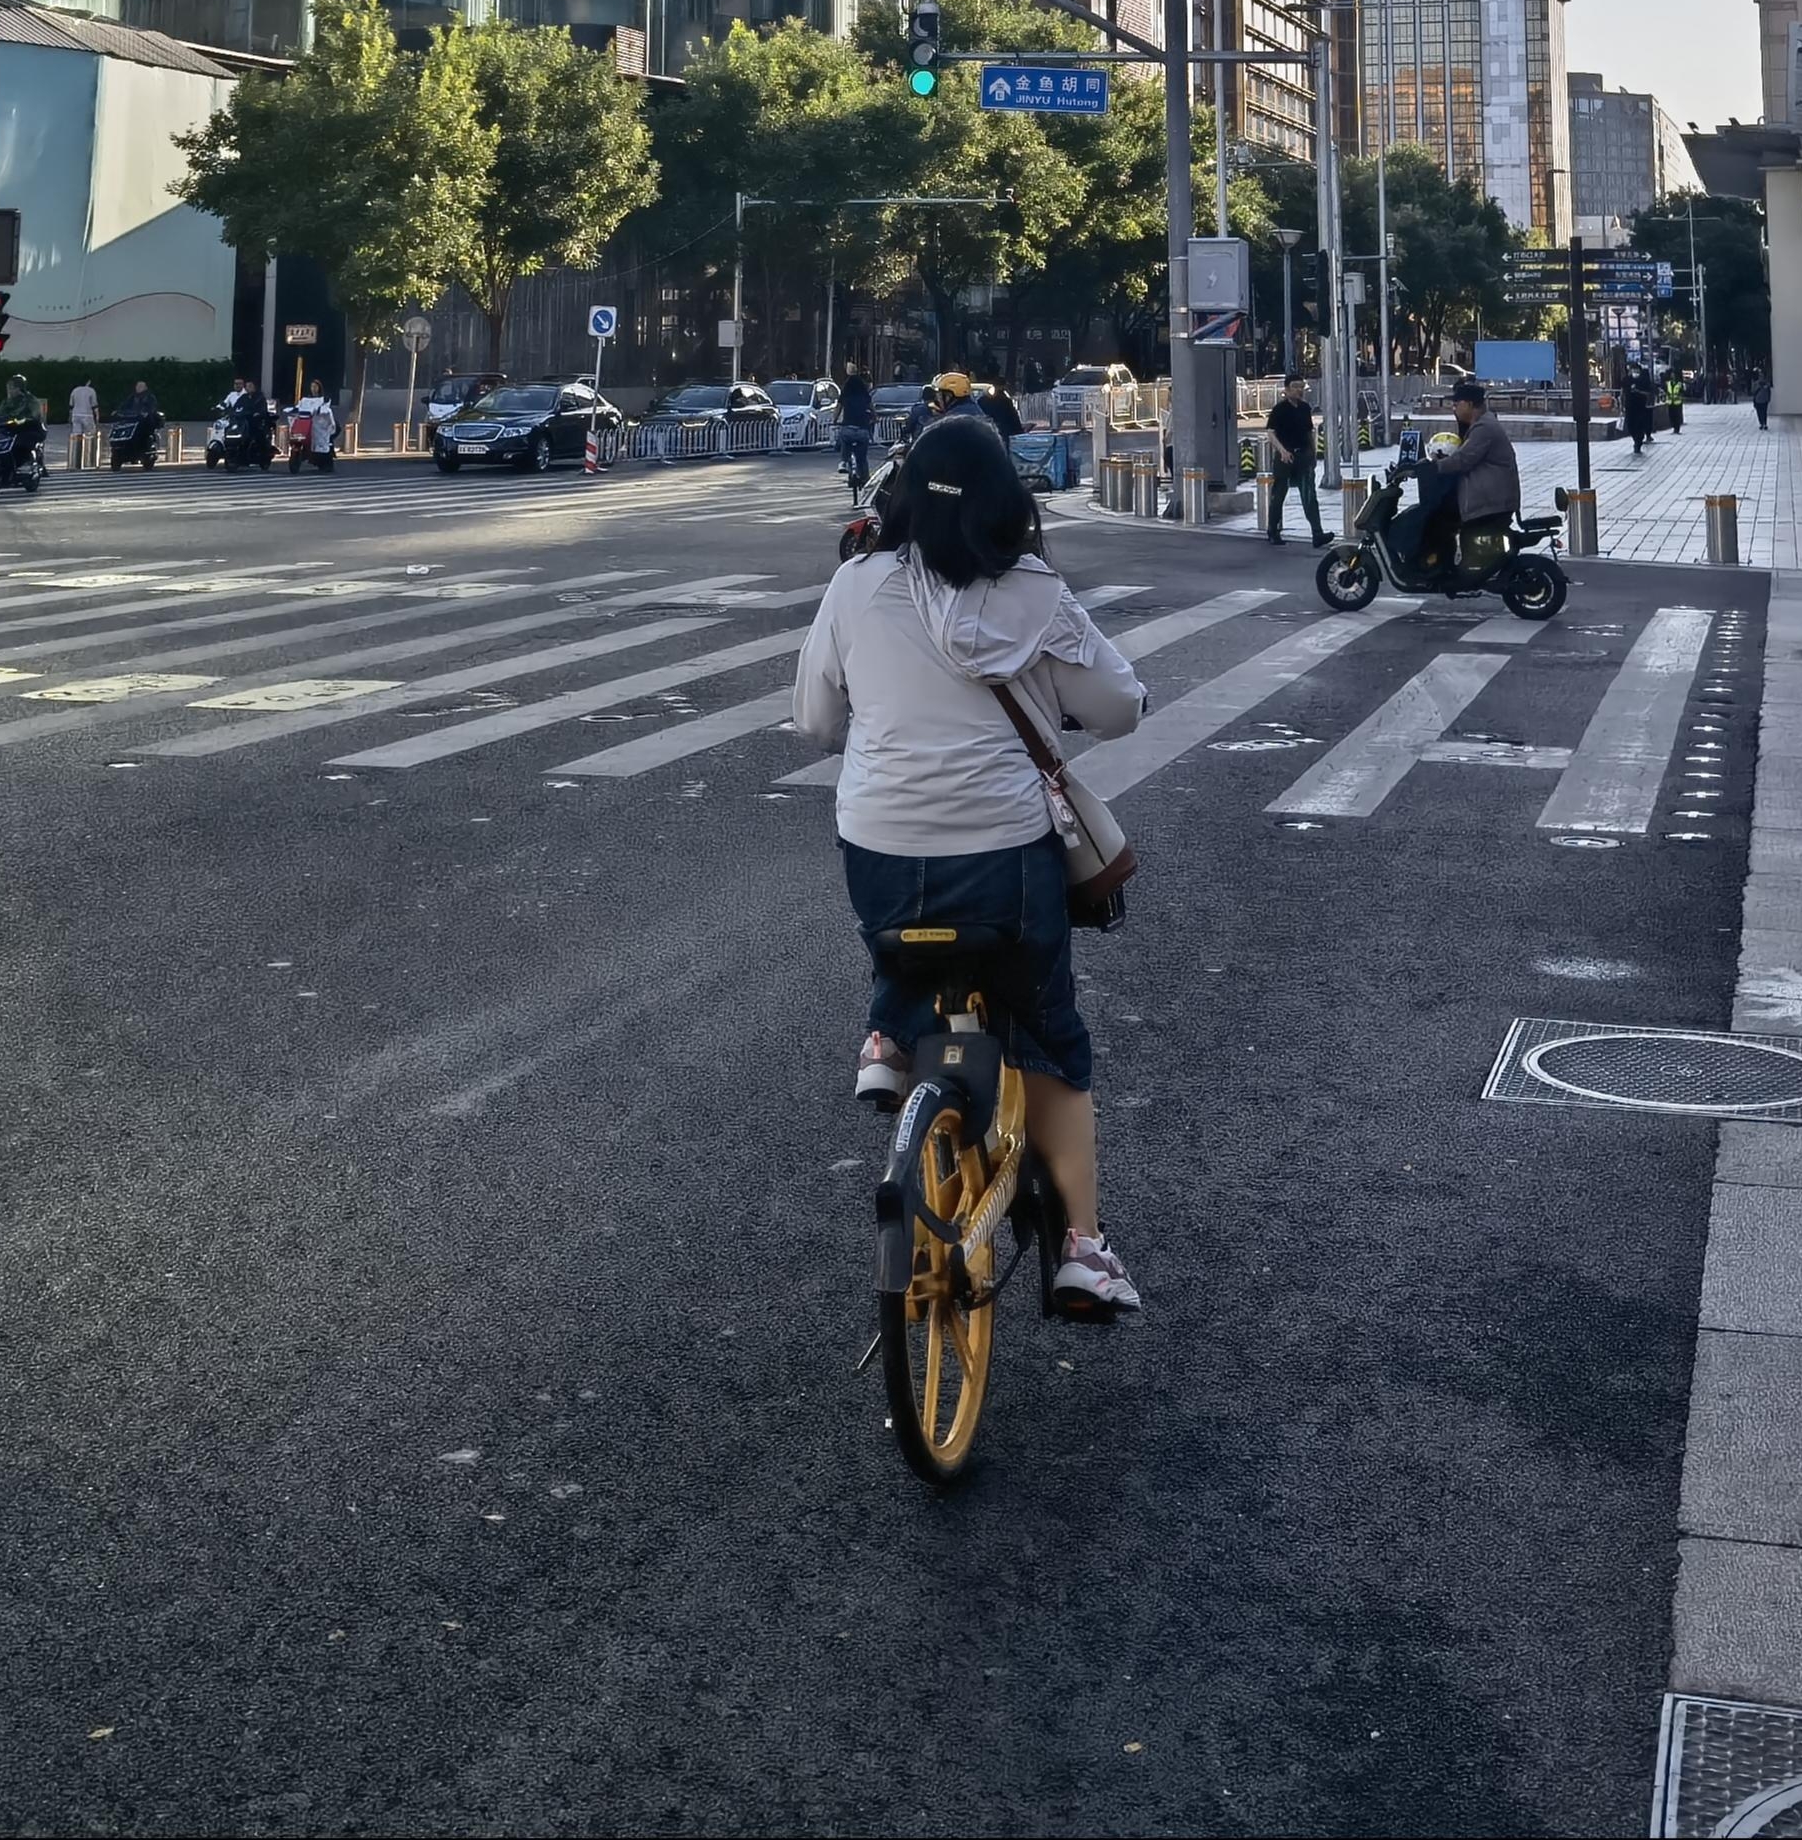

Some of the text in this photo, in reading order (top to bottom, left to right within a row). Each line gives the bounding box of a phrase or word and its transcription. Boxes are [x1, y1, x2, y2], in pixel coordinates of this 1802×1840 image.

[1015, 74, 1101, 94] 金鱼胡同
[1015, 94, 1099, 108] JINYU Hutong
